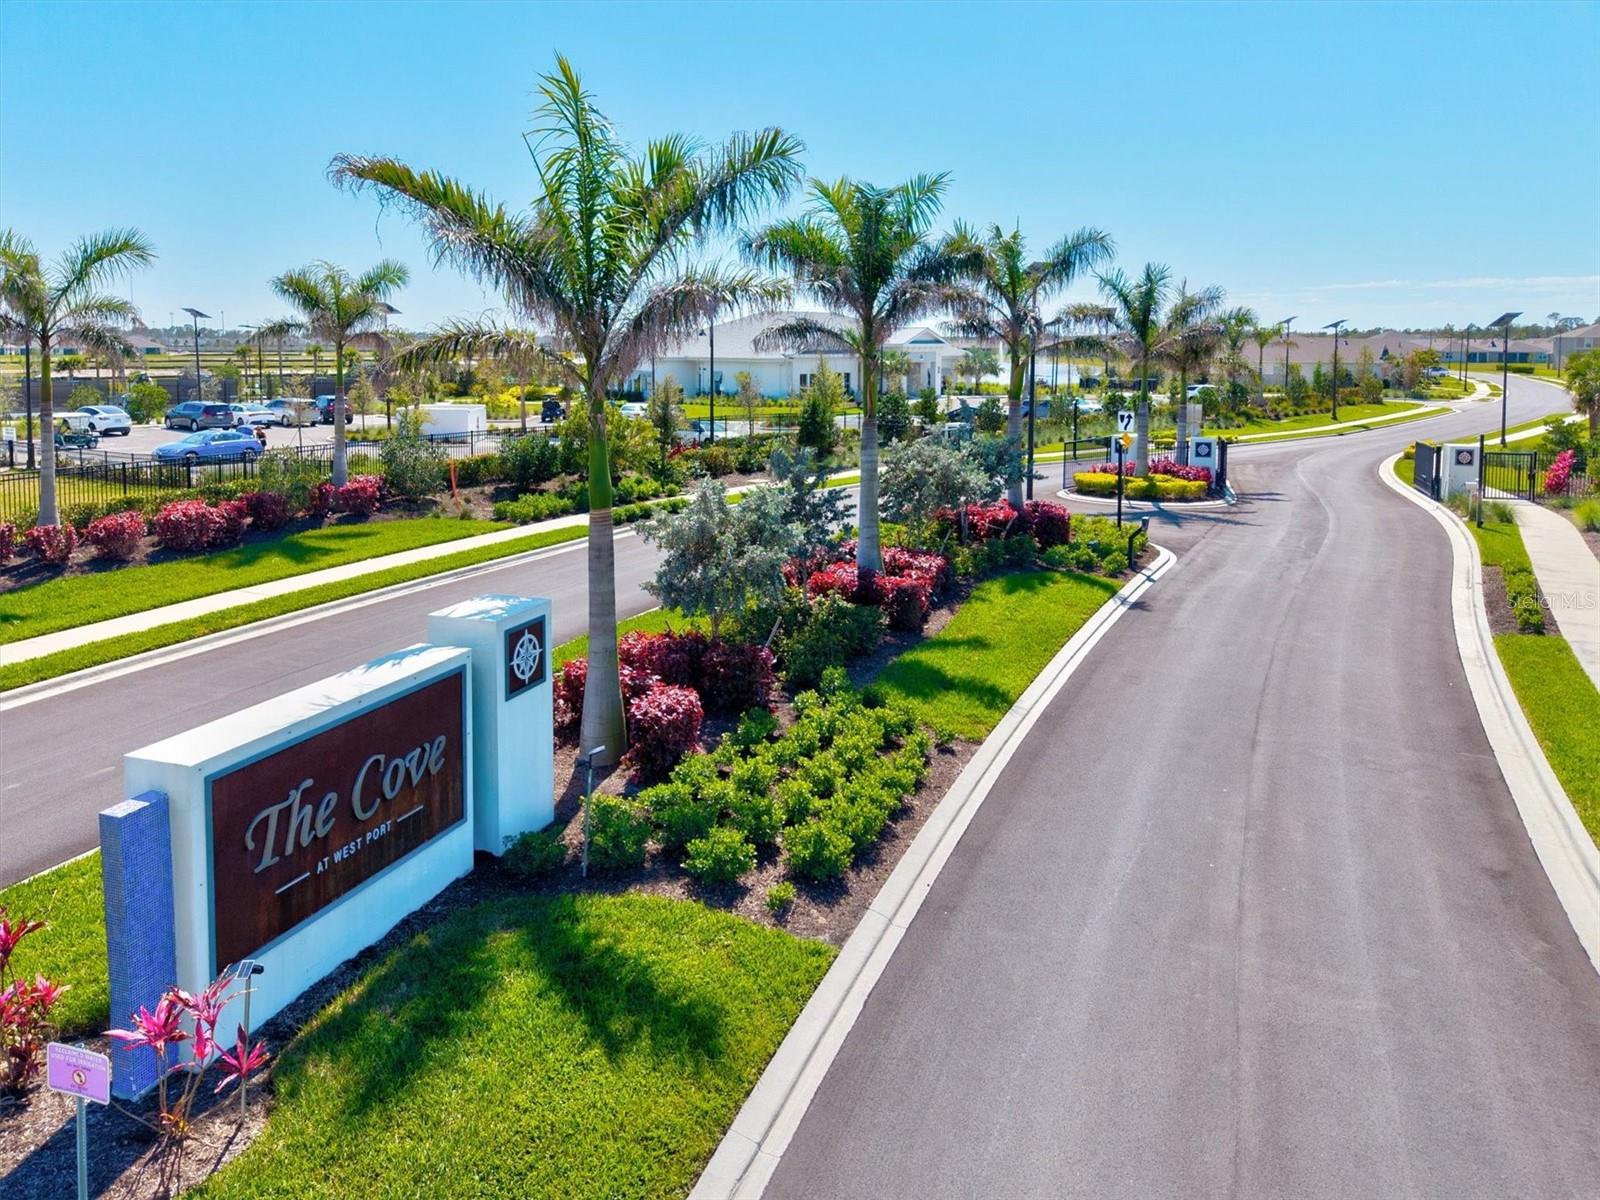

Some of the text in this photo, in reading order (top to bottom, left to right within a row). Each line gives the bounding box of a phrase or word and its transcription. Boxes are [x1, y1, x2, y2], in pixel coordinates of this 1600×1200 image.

[245, 735, 446, 873] The Cove
[316, 821, 392, 874] AT WEST PORT
